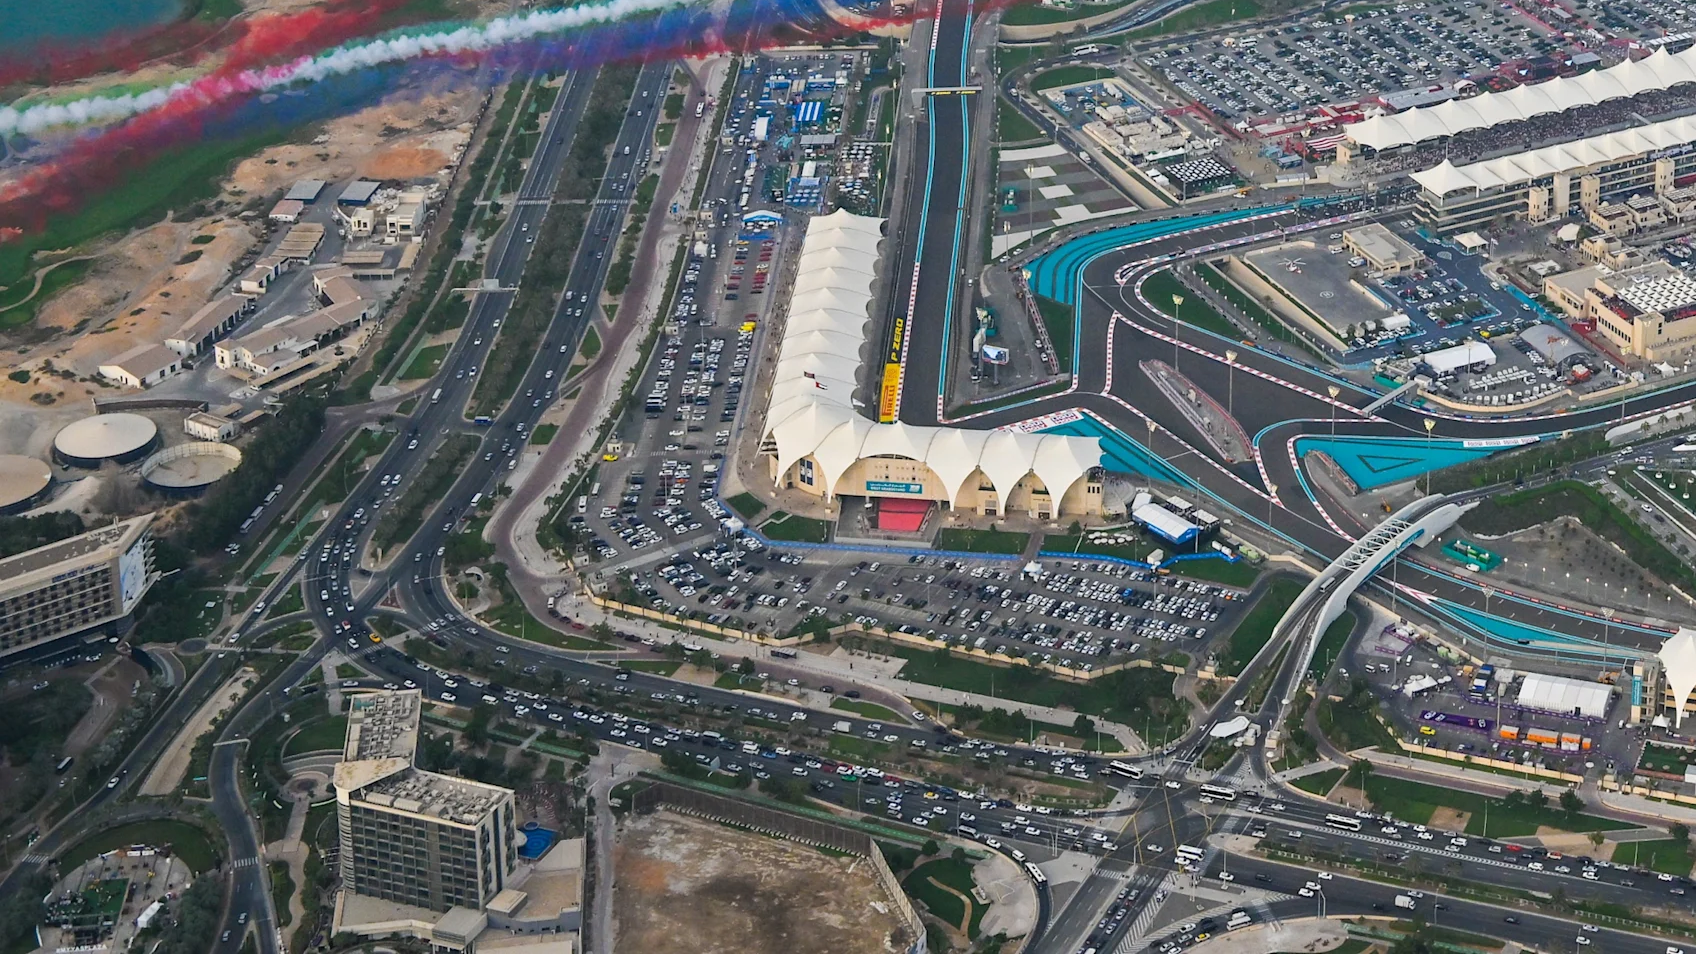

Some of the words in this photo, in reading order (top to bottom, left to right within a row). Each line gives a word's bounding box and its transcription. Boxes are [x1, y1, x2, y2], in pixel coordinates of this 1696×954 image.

[893, 318, 904, 351] ZERO
[891, 352, 898, 361] P
[882, 385, 895, 416] PIRELLI
